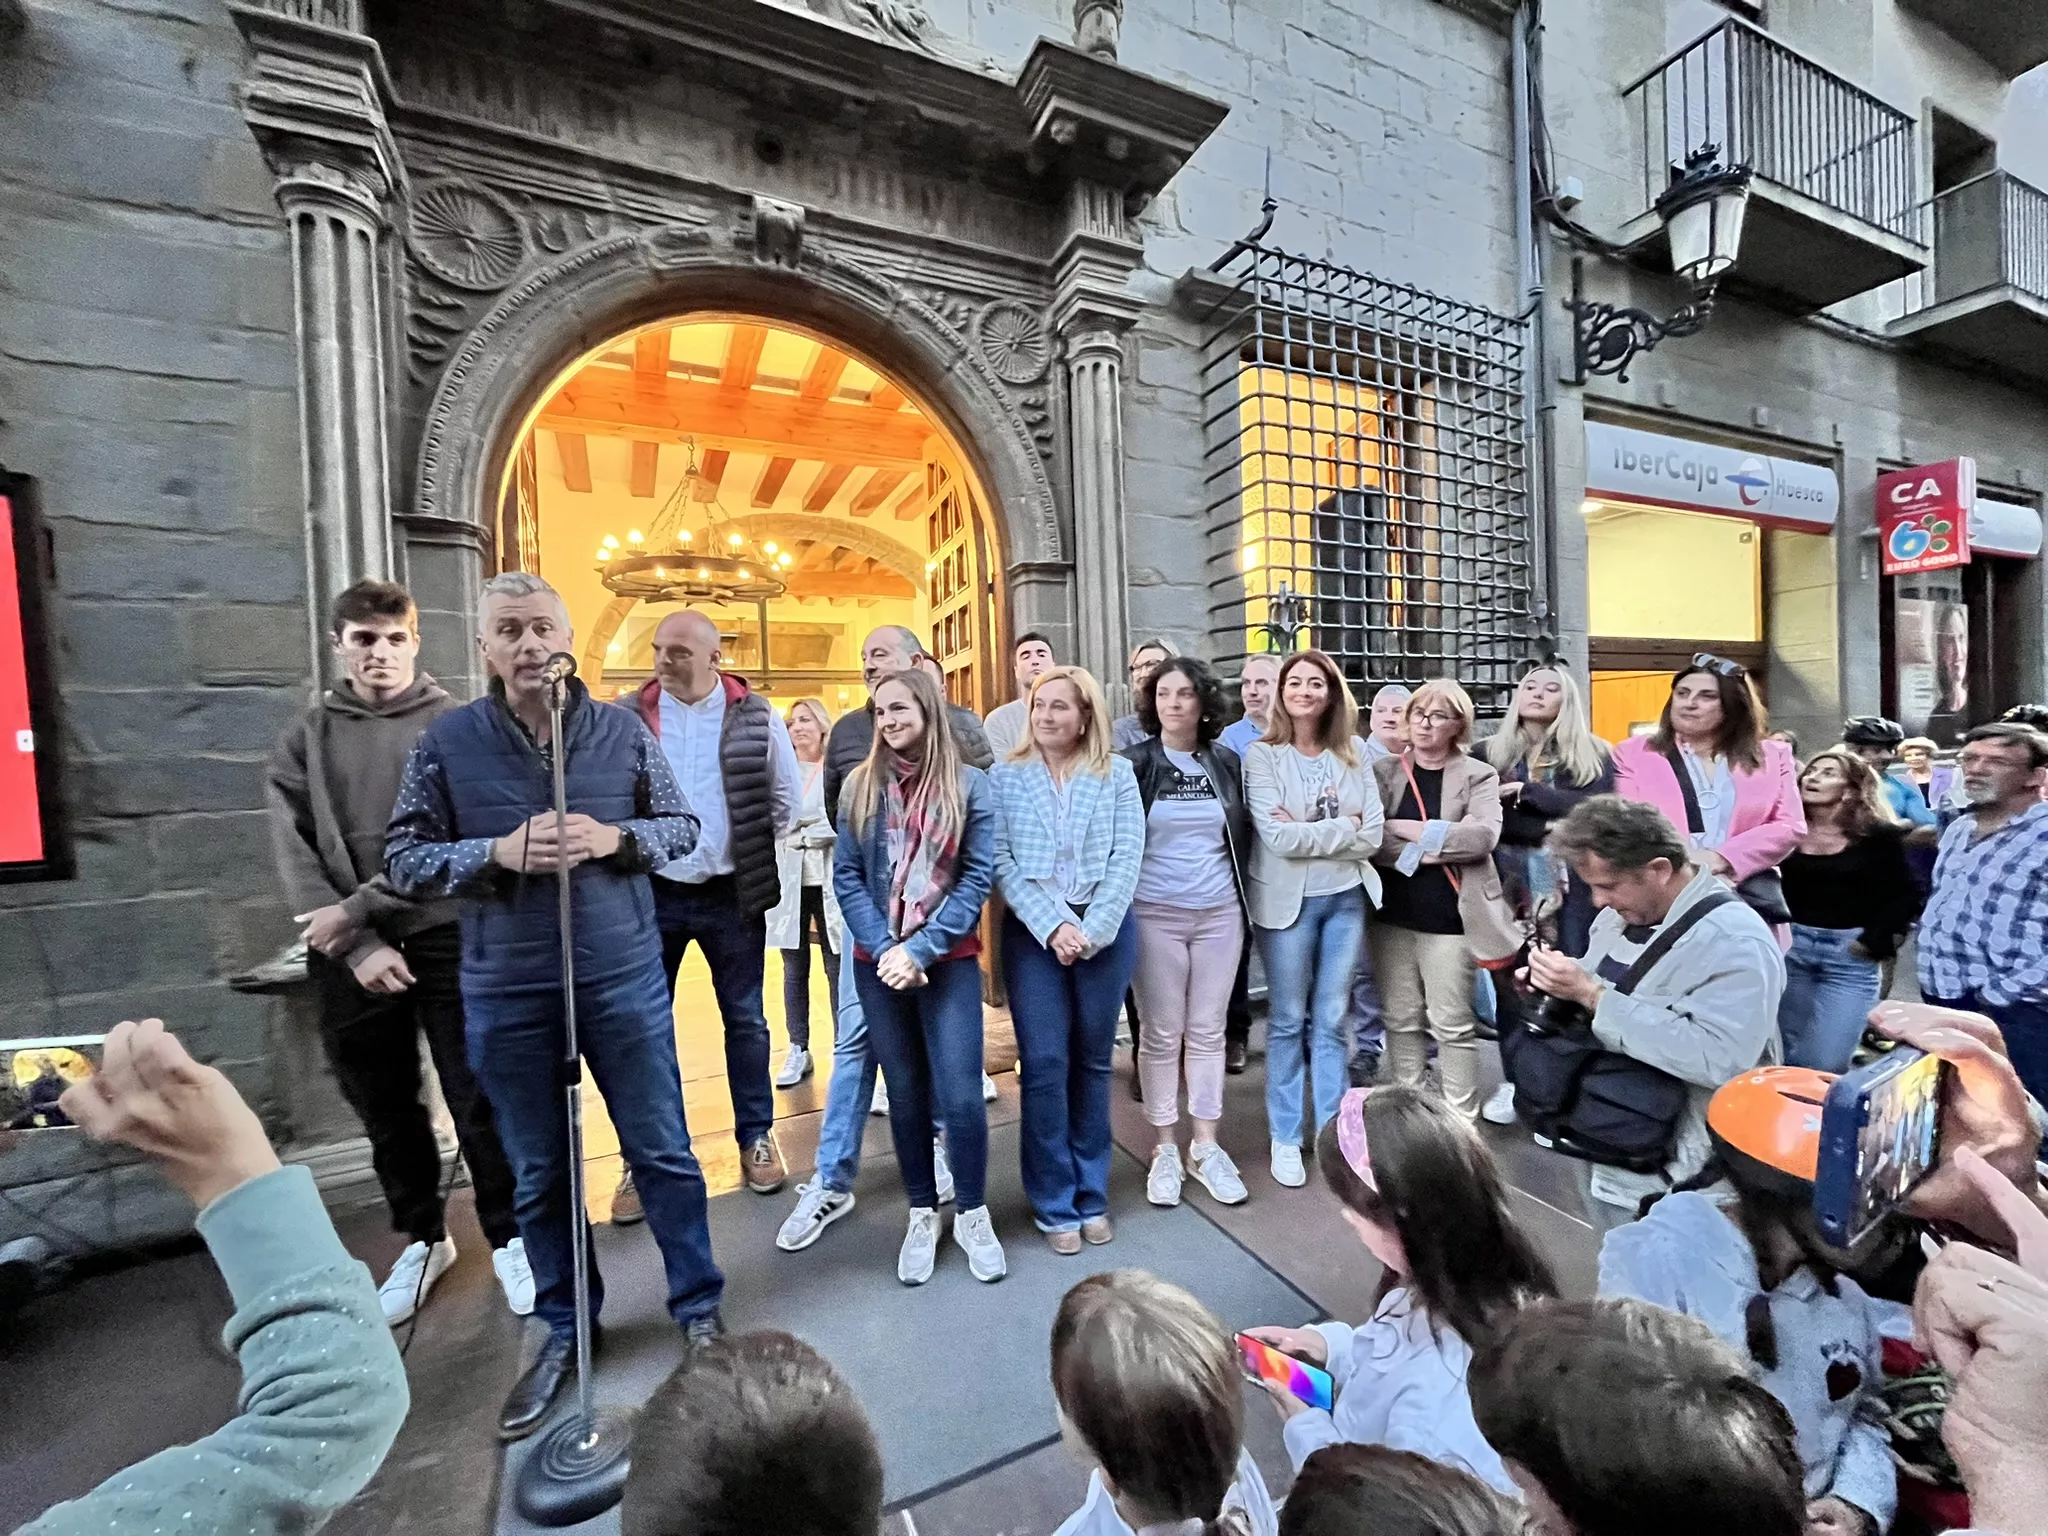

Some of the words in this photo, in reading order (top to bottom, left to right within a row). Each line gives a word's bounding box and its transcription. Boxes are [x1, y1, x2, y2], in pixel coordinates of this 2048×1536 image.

[1775, 477, 1825, 504] Huesca
[1891, 478, 1942, 503] CA
[1886, 561, 1920, 572] EURO
[1921, 553, 1959, 567] 6000
